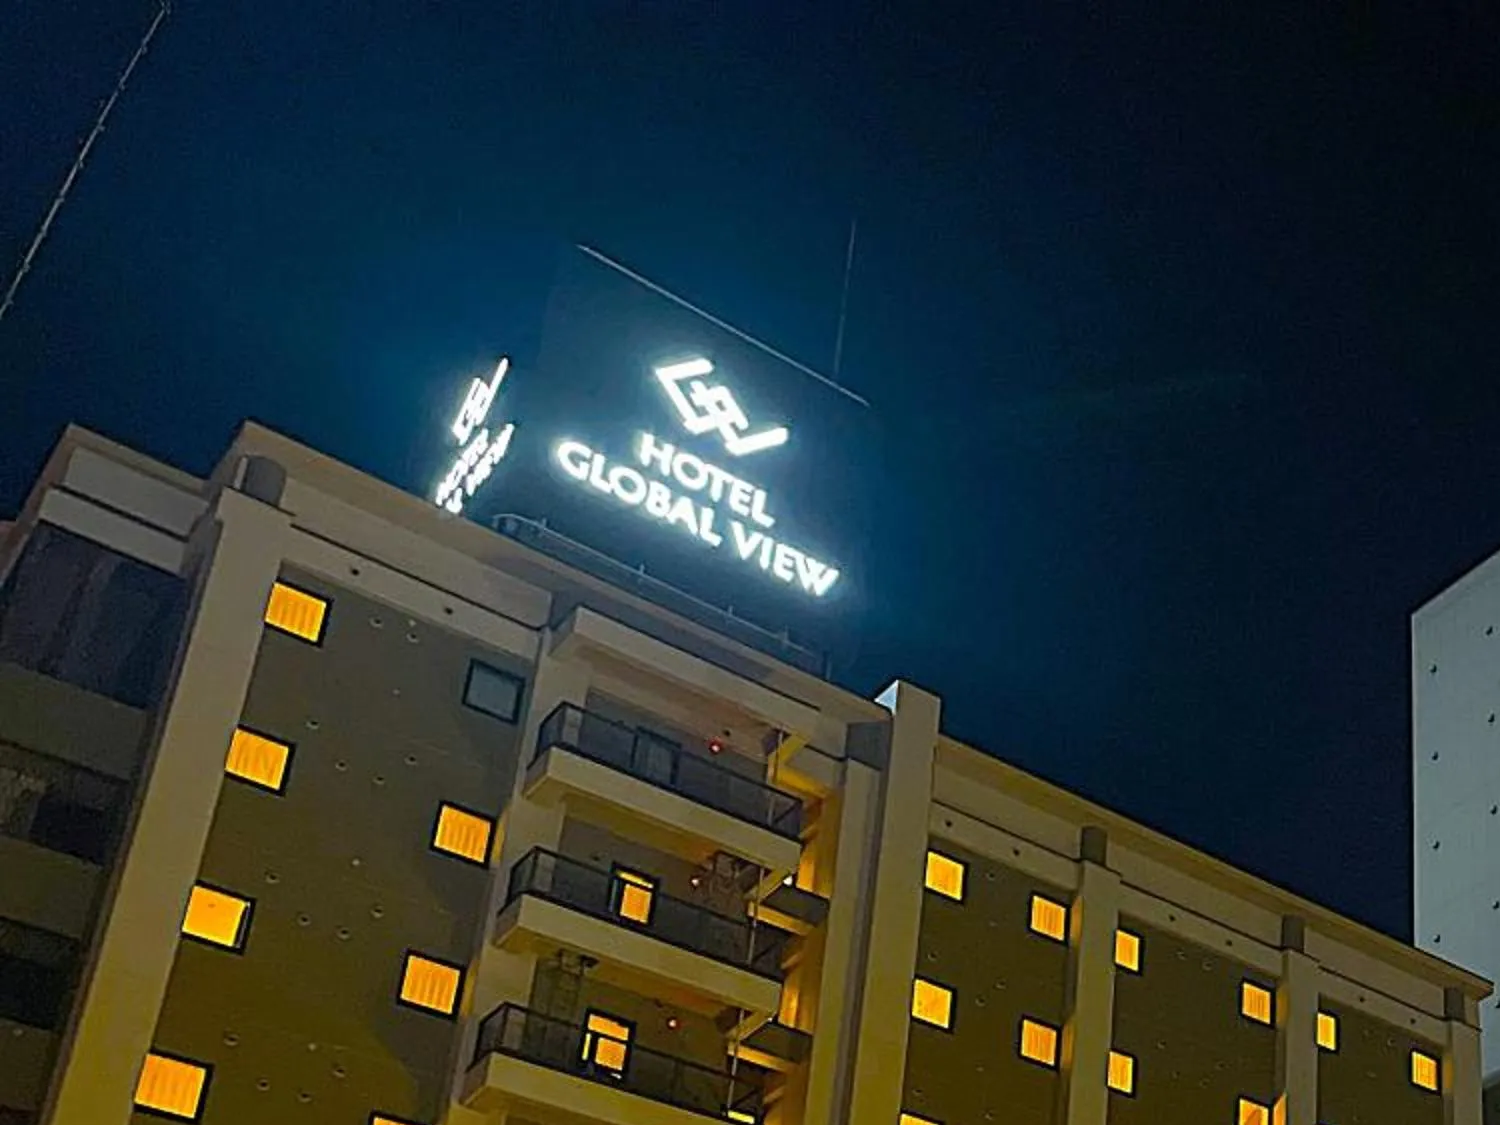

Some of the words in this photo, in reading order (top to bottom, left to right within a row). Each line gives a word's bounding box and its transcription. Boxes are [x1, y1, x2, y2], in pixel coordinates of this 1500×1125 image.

[554, 440, 722, 546] GLOBAL
[731, 520, 840, 597] VIEW
[636, 431, 775, 528] HOTEL
